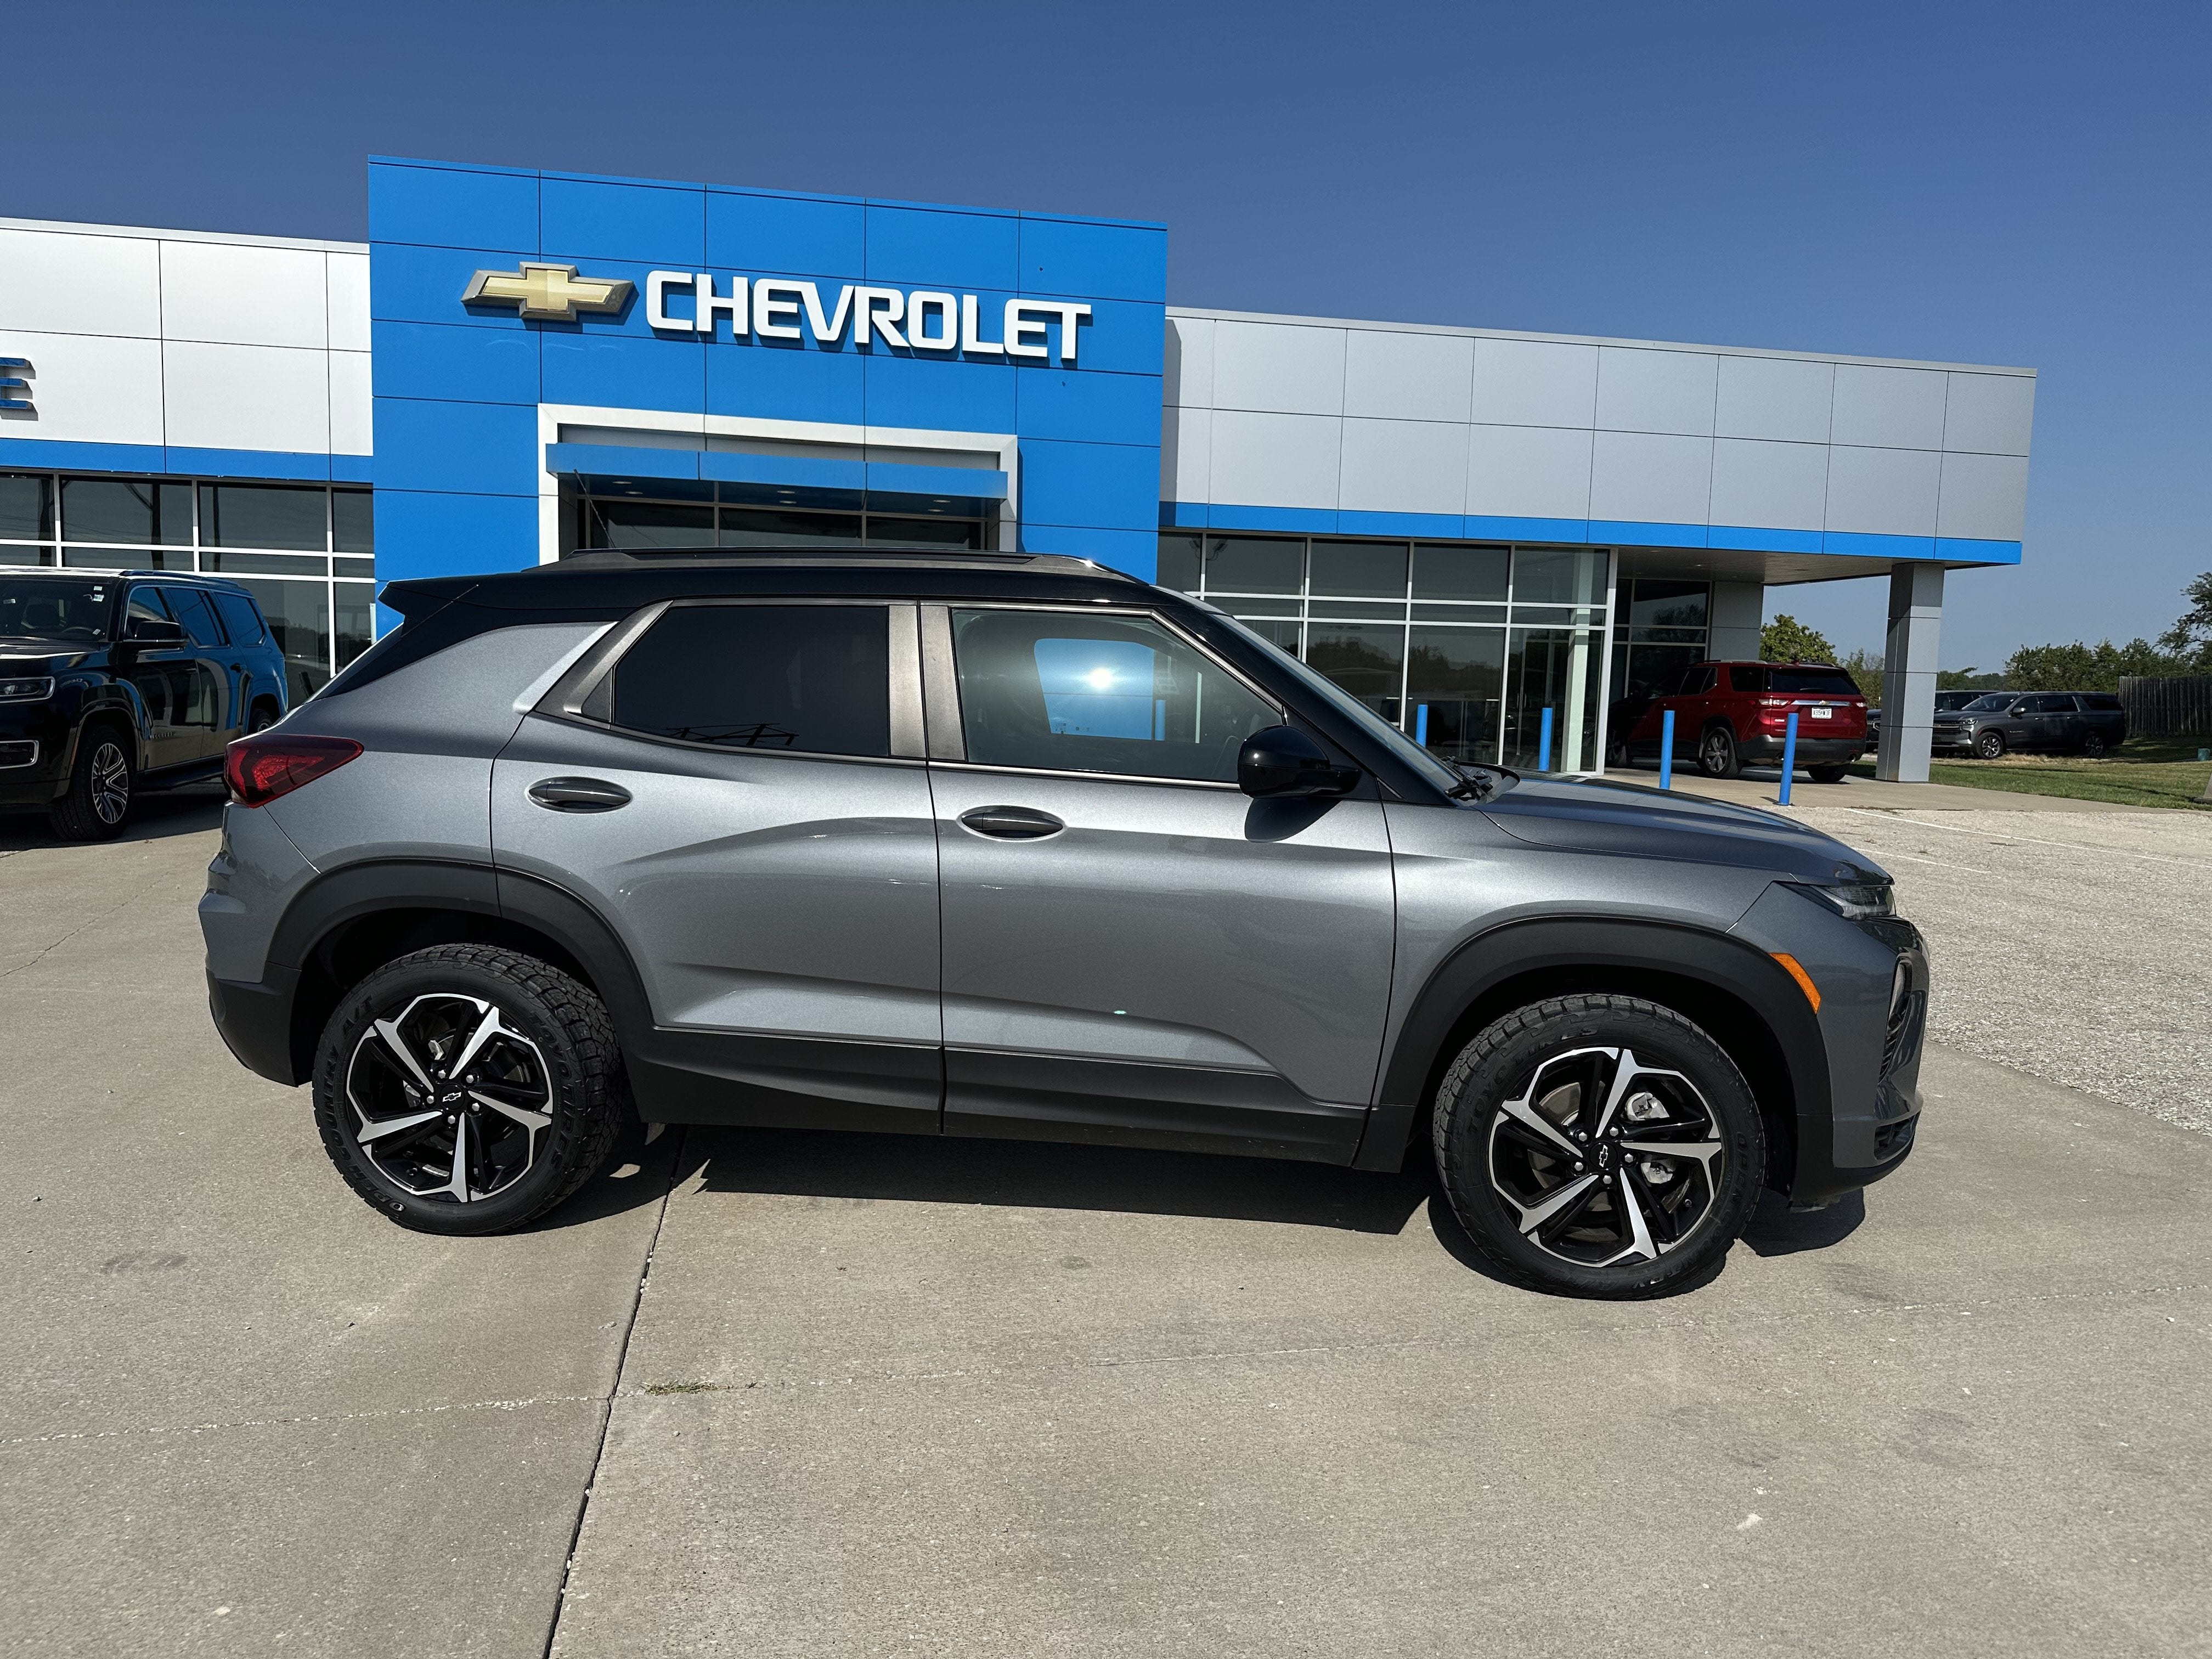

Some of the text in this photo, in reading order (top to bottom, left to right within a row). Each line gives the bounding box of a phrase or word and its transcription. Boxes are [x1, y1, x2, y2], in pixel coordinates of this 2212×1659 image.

[646, 270, 1092, 360] CHEVROLET
[323, 1041, 351, 1160] COUNTRY
[527, 1011, 575, 1169] TOYO TIRES
[1468, 1063, 1508, 1133] TOYO
[348, 1164, 406, 1212] OPEN
[1732, 1131, 1747, 1207] OPEN
